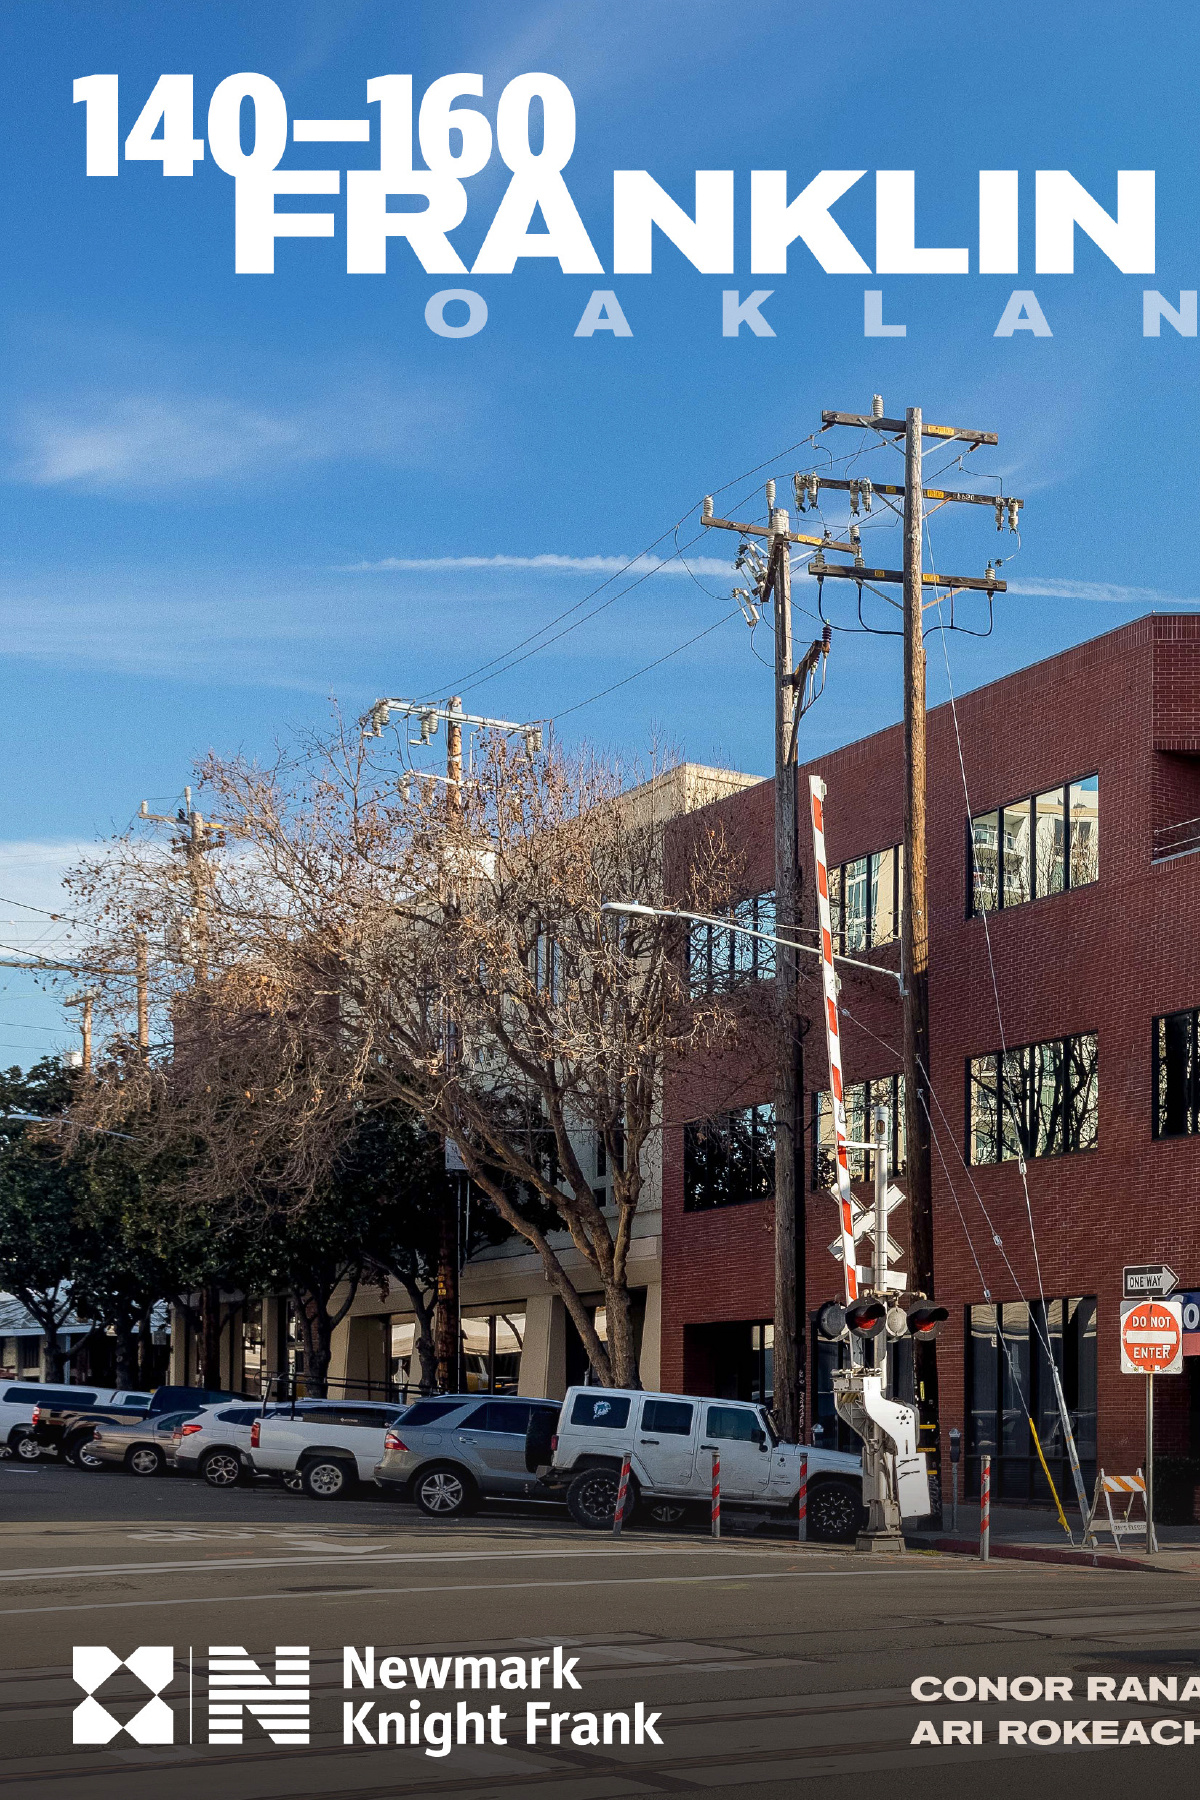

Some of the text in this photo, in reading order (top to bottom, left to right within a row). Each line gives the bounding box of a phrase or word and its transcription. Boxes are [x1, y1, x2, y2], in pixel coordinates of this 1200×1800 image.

[1129, 1275, 1162, 1288] ONE WAY
[1132, 1316, 1171, 1328] DO NOT
[1133, 1347, 1170, 1359] ENTER
